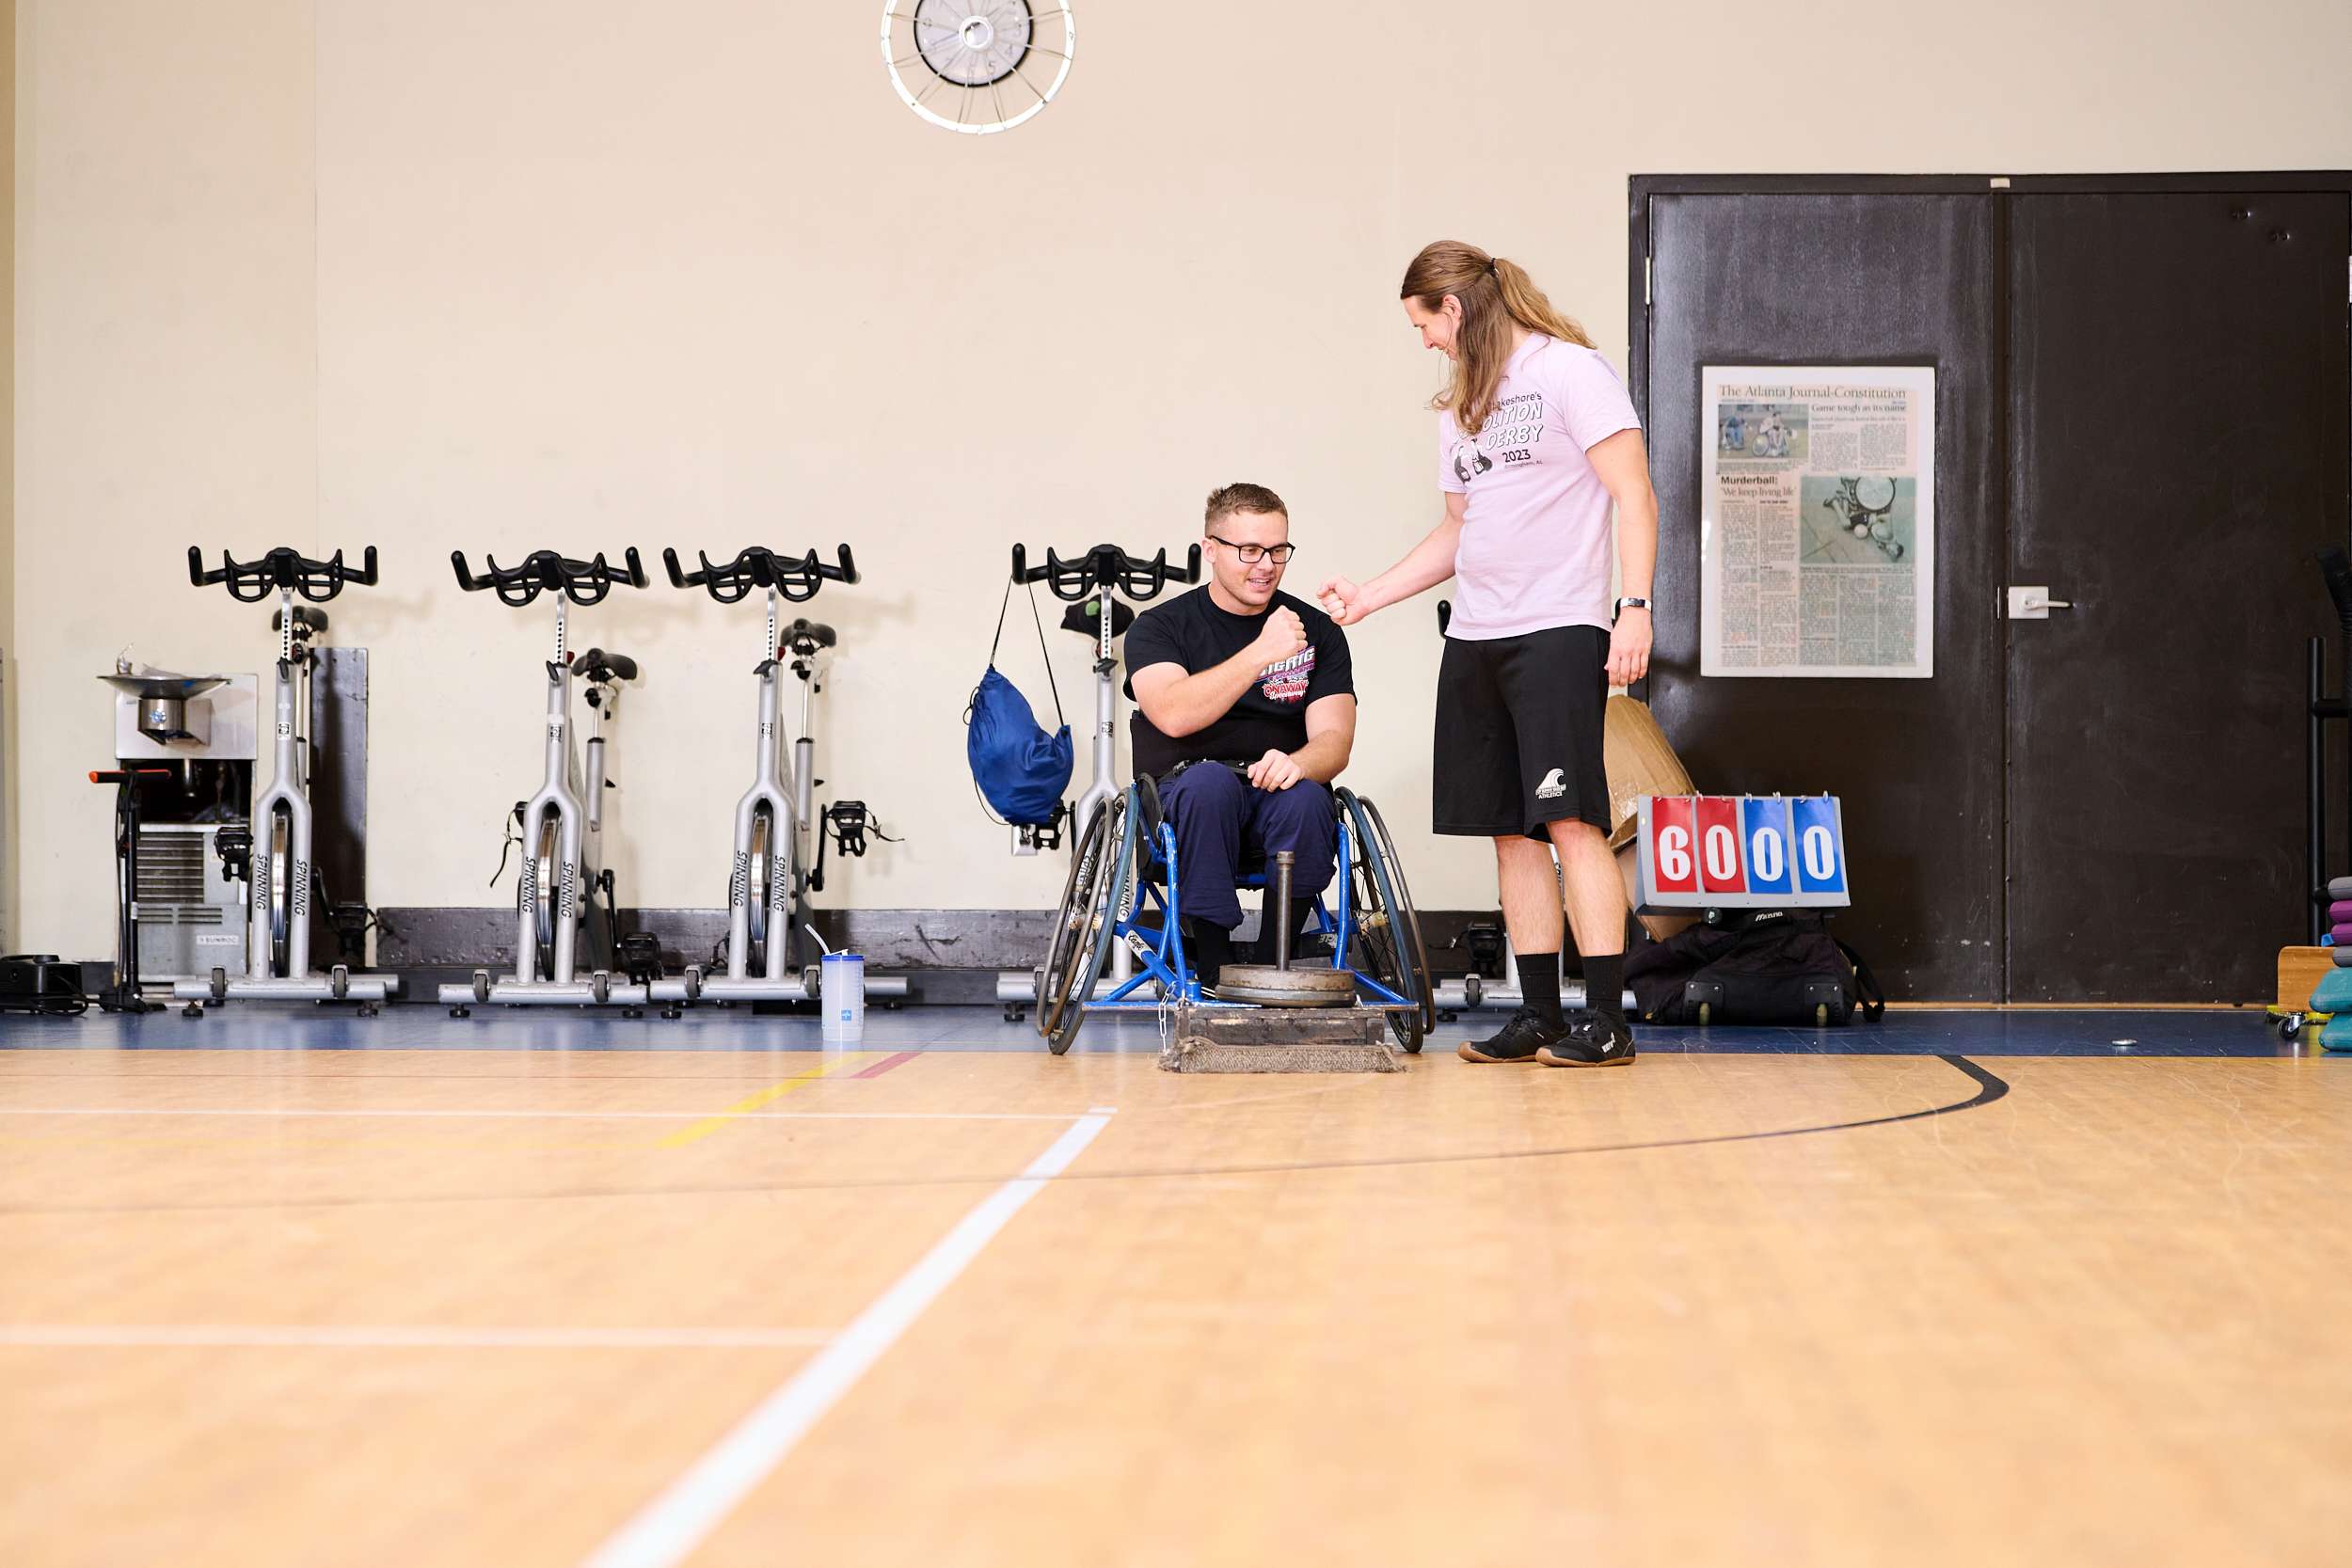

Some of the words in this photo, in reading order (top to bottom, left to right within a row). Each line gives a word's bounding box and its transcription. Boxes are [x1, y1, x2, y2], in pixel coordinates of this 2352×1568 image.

[1720, 385, 1741, 397] The
[1745, 385, 1786, 397] Atlanta
[1788, 385, 1906, 399] Journal-Constitution
[1483, 402, 1543, 432] OLITION
[1837, 404, 1860, 414] tough
[1486, 424, 1543, 451] DERBY
[1502, 449, 1532, 463] 2023
[1721, 476, 1778, 484] Murderball:
[1739, 487, 1757, 498] keep
[1759, 487, 1782, 498] living
[256, 854, 268, 911] SPINNING
[294, 859, 308, 916] SPINNING
[522, 857, 536, 913] SPINNING
[562, 862, 574, 918] SPINNING
[734, 850, 748, 907] SPINNING
[773, 855, 786, 911] SPINNING
